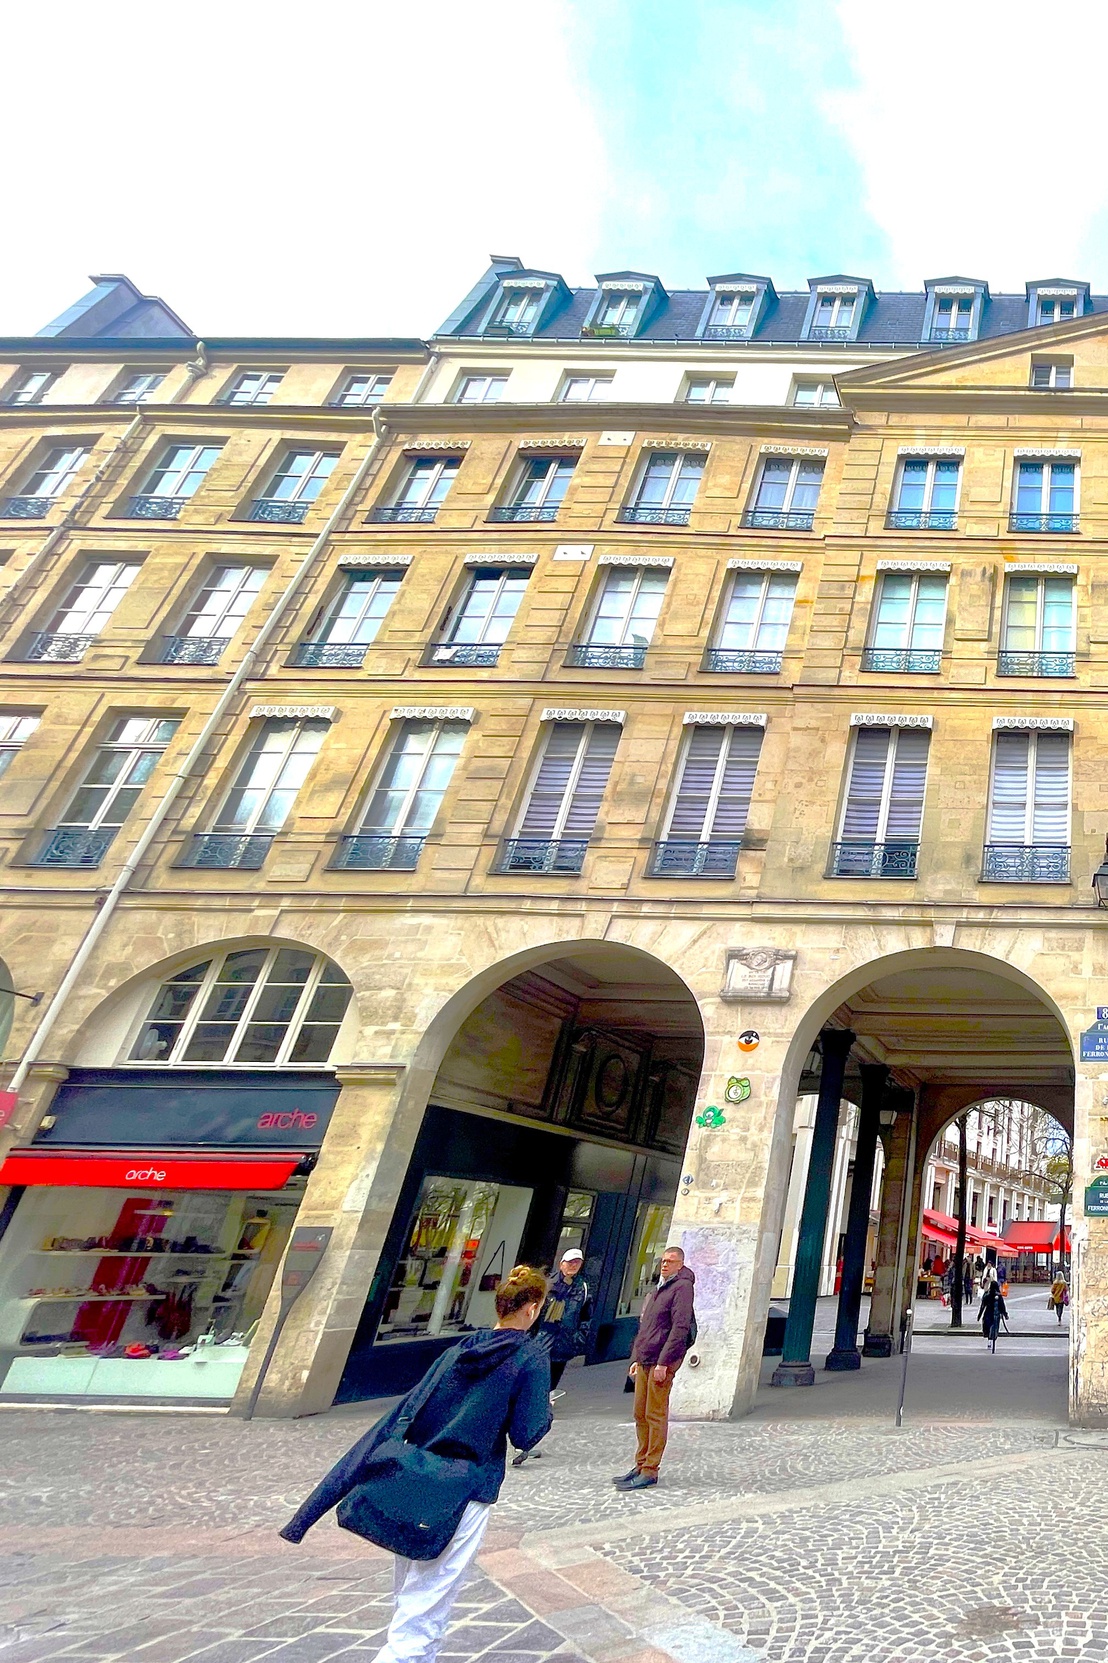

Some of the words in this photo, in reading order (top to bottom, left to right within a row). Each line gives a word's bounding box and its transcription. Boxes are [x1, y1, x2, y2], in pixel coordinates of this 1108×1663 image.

[1102, 1008, 1108, 1019] 8
[257, 1108, 318, 1129] arche
[125, 1167, 166, 1181] arche
